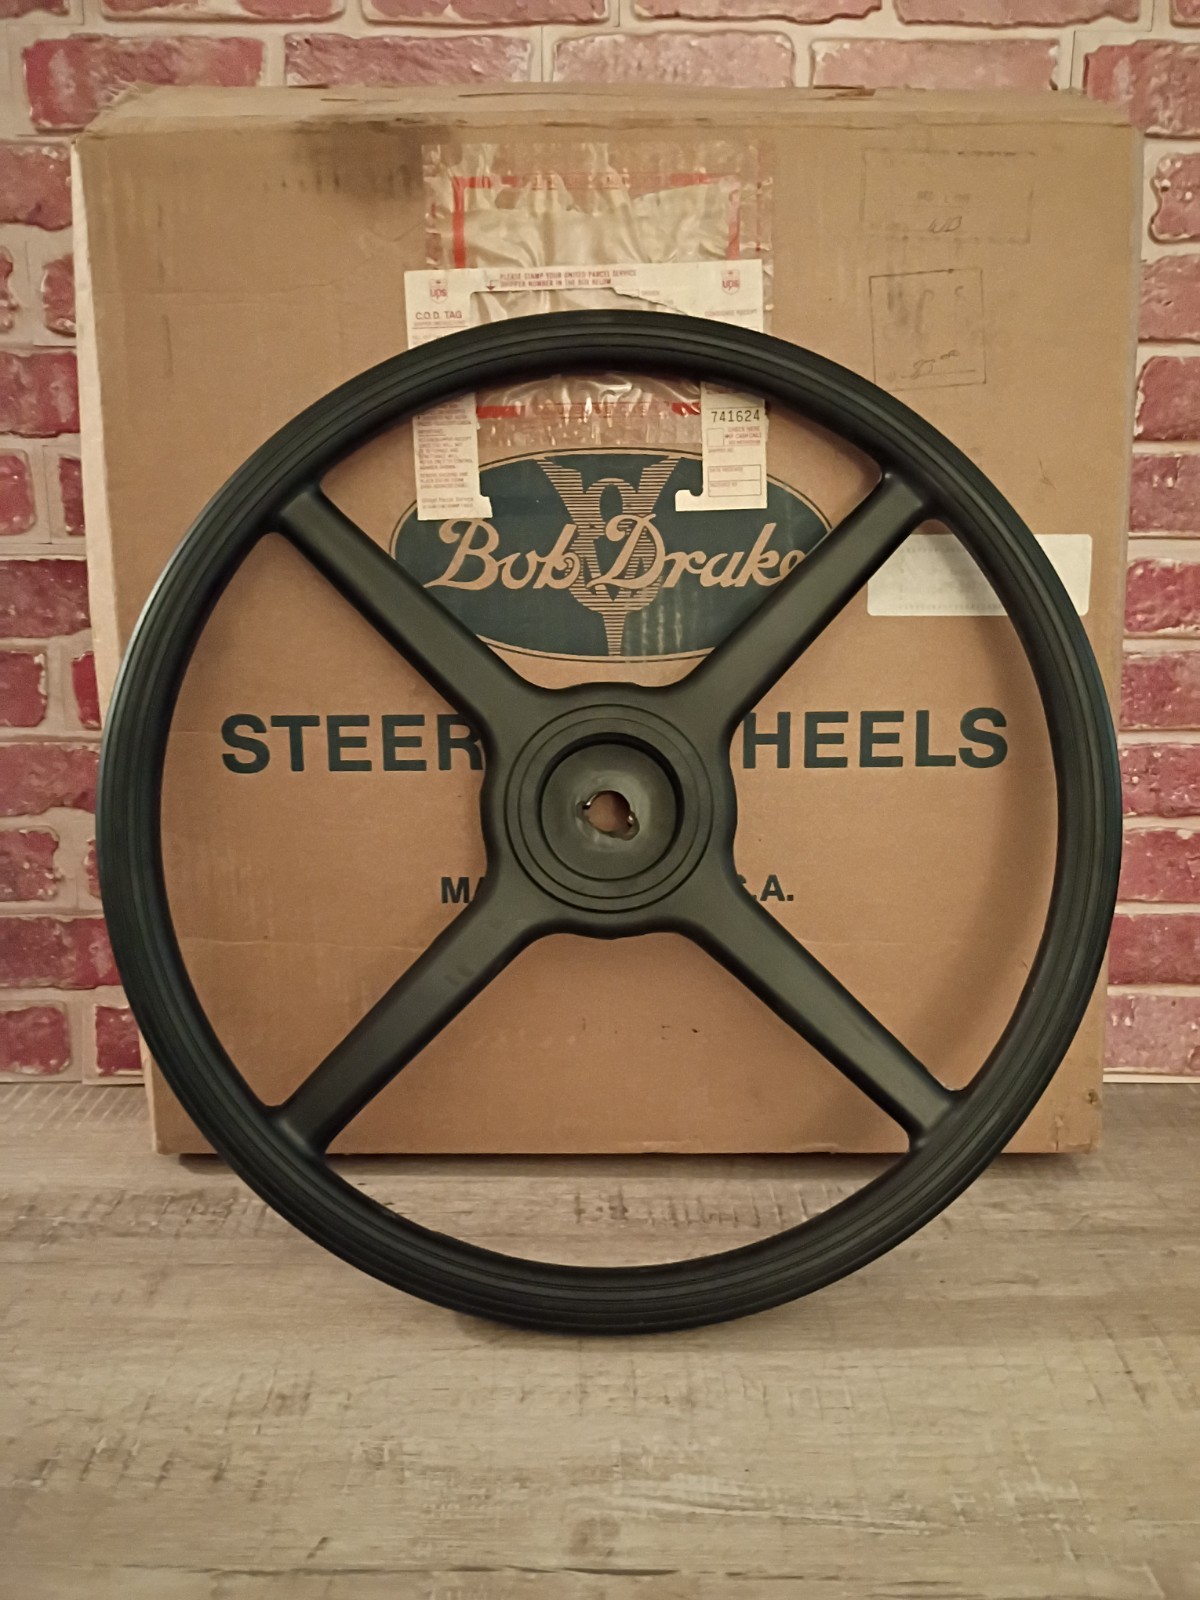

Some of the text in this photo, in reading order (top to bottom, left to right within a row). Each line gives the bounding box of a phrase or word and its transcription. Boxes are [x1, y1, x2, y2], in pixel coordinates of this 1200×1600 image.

[500, 272, 521, 280] PLEASE
[430, 289, 448, 300] ups
[444, 310, 463, 319] TAG
[711, 409, 761, 423] 741624
[424, 513, 805, 591] Bob Drake
[221, 713, 483, 774] STEER
[743, 707, 1009, 769] HEELS
